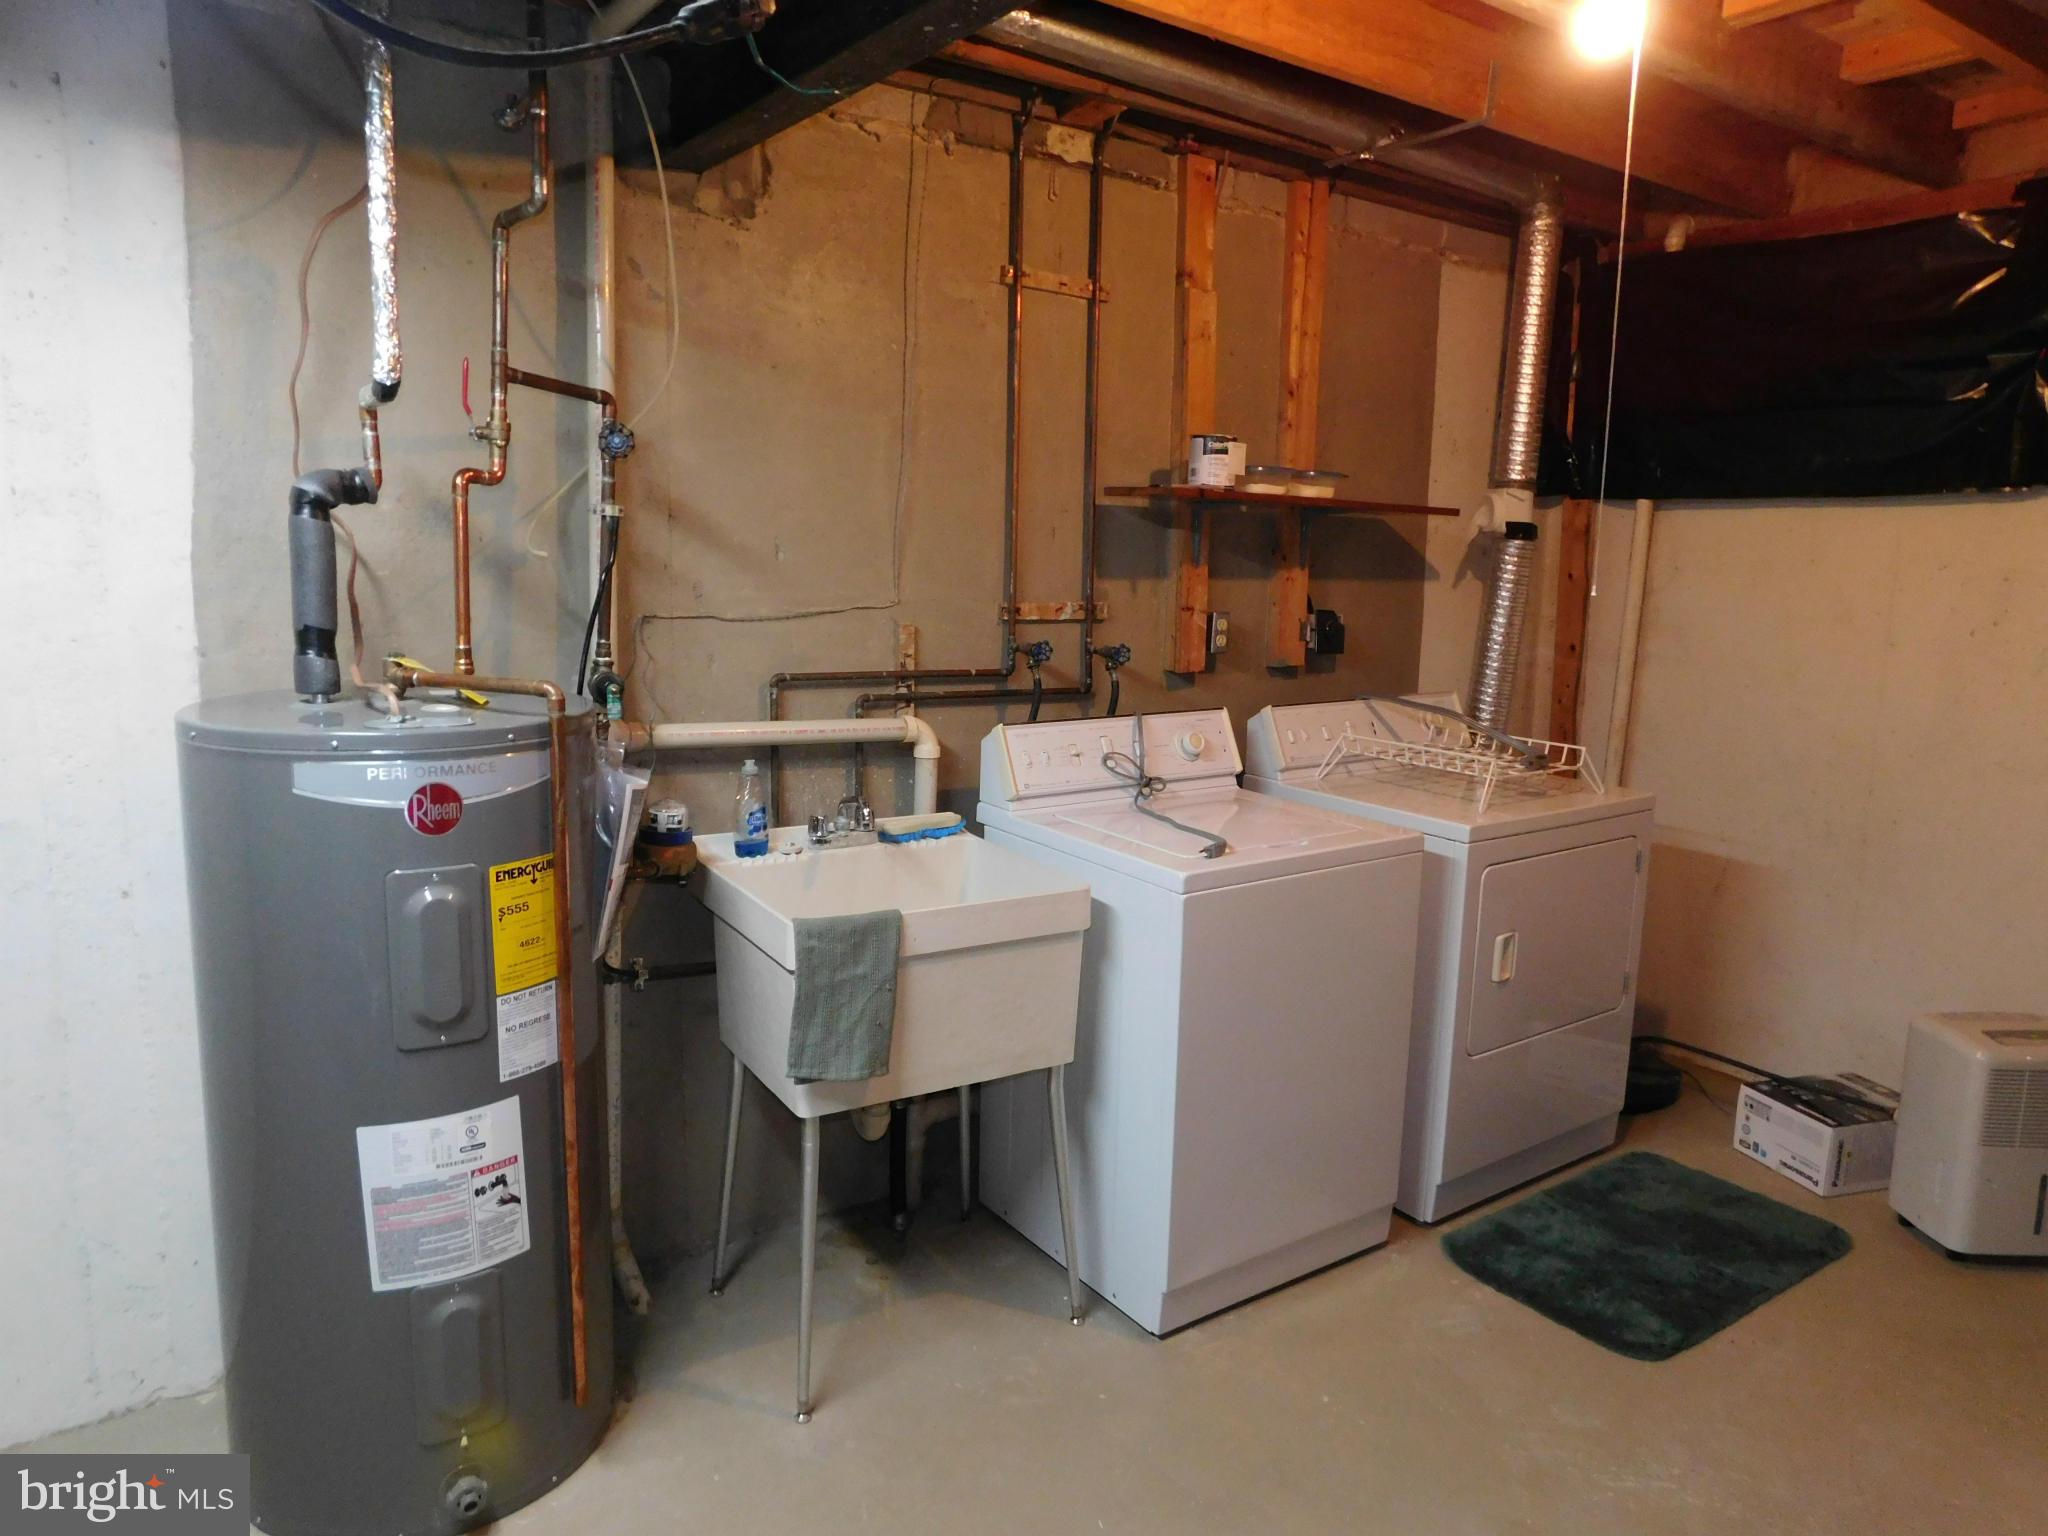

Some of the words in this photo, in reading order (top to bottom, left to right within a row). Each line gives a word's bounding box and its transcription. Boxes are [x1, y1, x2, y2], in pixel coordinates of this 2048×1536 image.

[412, 783, 461, 828] Rheem
[498, 901, 530, 919] $555
[501, 997, 512, 1006] DO
[513, 993, 527, 1002] NOT
[528, 984, 553, 997] RETURN
[505, 1025, 517, 1033] NO
[482, 1156, 516, 1175] DANGER
